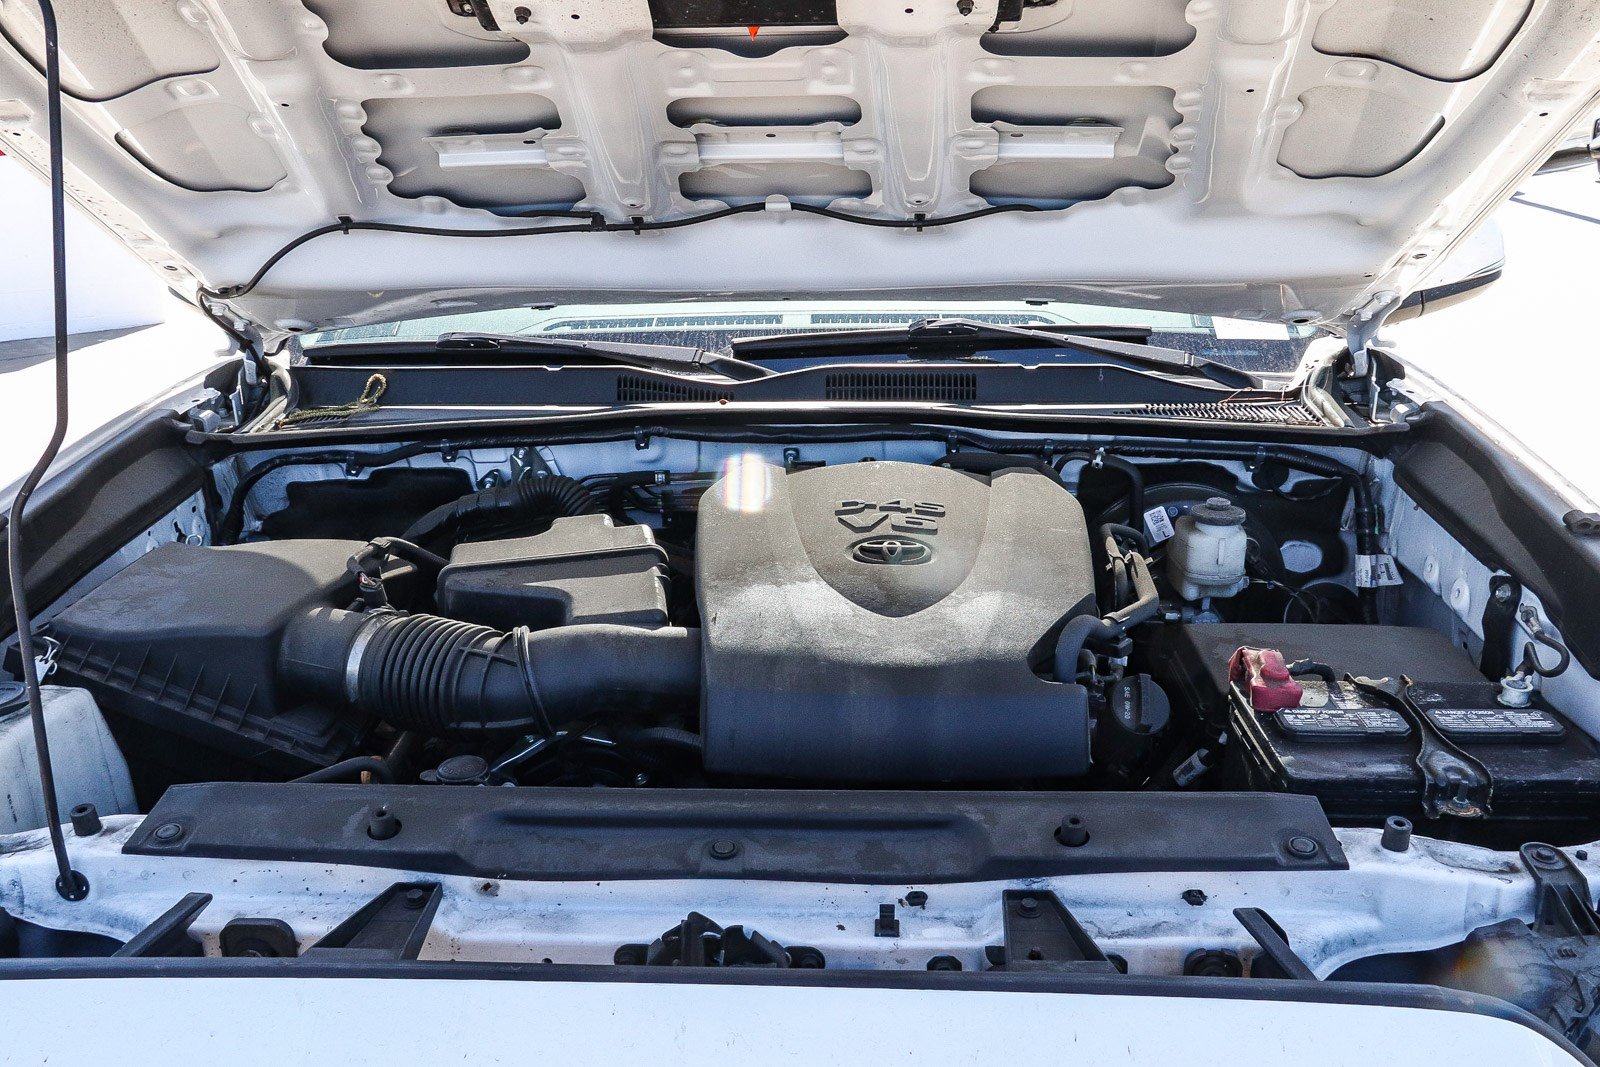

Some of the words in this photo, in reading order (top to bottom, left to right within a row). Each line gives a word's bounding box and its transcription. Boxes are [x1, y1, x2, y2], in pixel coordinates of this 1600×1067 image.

[835, 499, 946, 518] D-4S
[838, 512, 938, 536] V6
[1123, 686, 1131, 698] SAE
